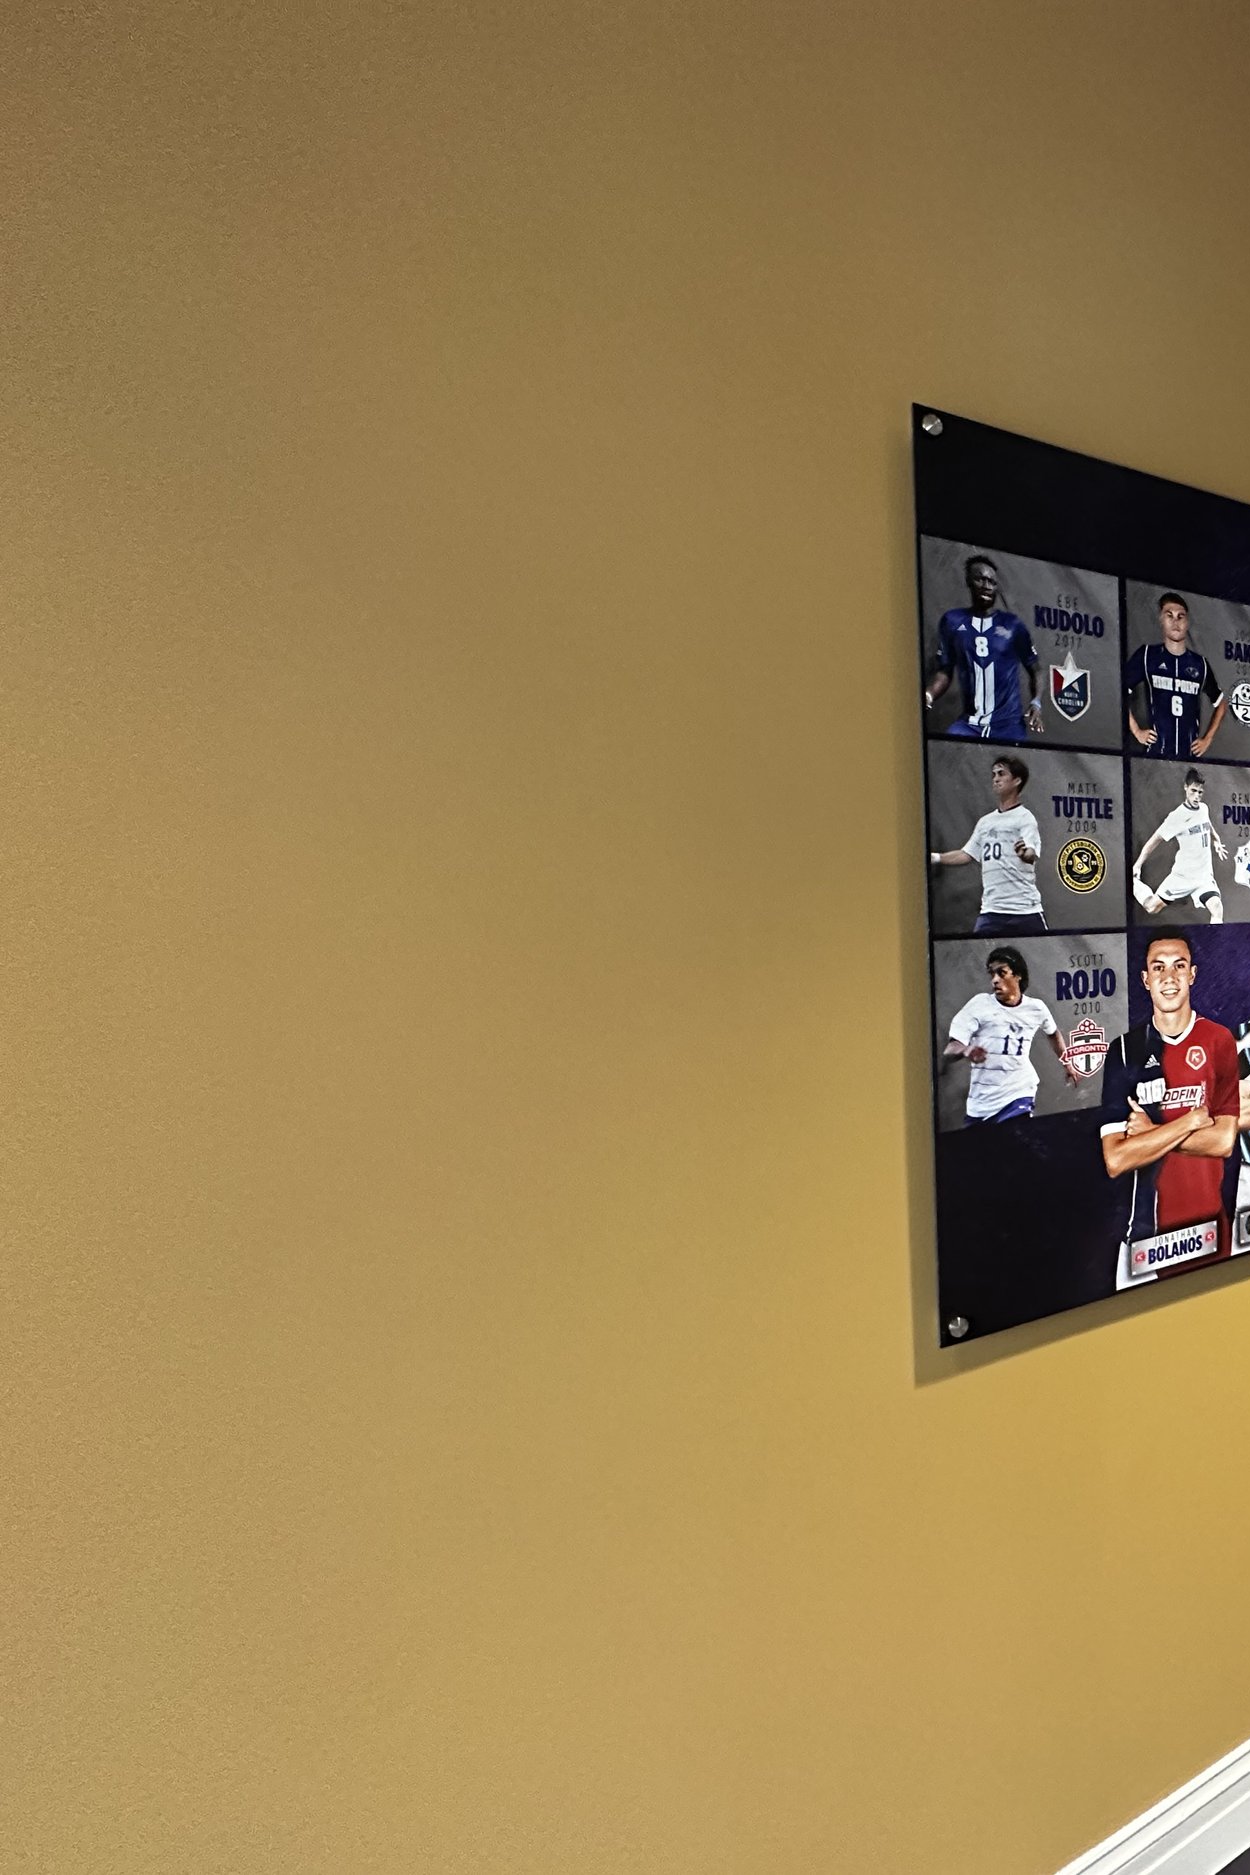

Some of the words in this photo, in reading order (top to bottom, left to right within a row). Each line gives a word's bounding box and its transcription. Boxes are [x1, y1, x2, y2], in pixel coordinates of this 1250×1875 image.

[1034, 604, 1104, 638] KUDOLO
[975, 636, 989, 657] 8
[1171, 695, 1183, 717] 6
[1052, 795, 1114, 820] TUTTLE
[1067, 820, 1097, 833] 2009
[984, 842, 1001, 861] 20
[1070, 953, 1105, 968] SCOTT
[1056, 967, 1116, 1001] ROJO
[1074, 1001, 1101, 1016] 2010
[1002, 1035, 1024, 1056] 11
[1068, 1045, 1107, 1056] TORONTO
[1163, 1088, 1198, 1101] ODFIN
[1154, 1227, 1198, 1247] JONATHAN
[1148, 1234, 1203, 1265] BOLANOS
